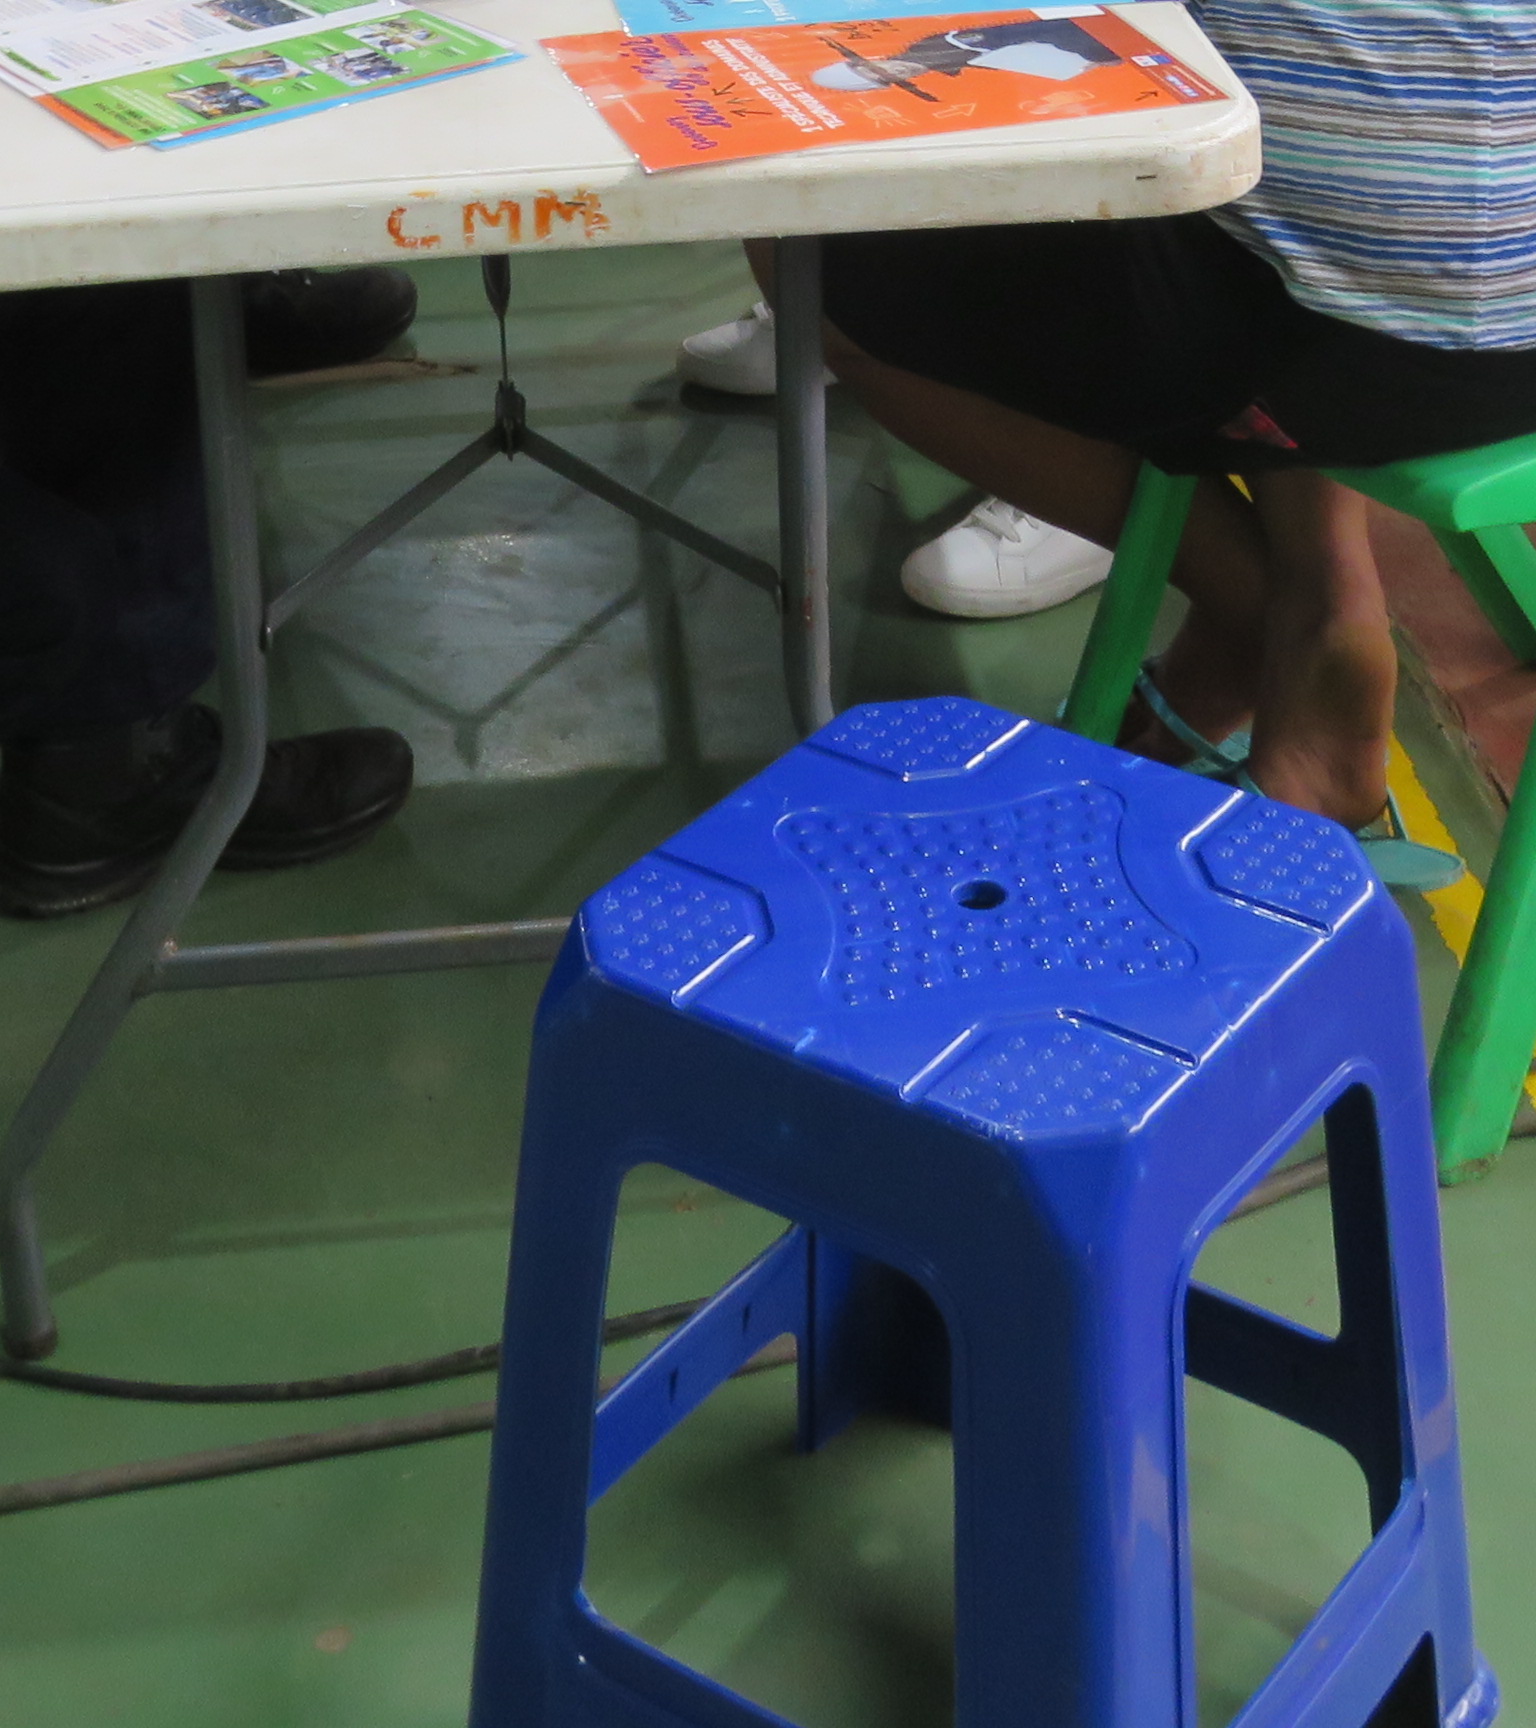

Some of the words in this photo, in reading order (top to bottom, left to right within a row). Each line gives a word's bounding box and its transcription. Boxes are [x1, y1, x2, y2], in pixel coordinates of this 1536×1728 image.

[698, 38, 753, 71] DOMAINES
[737, 71, 770, 85] DES
[775, 81, 804, 91] ET
[754, 85, 817, 126] SPÉCIALISTE
[797, 125, 825, 133] 1
